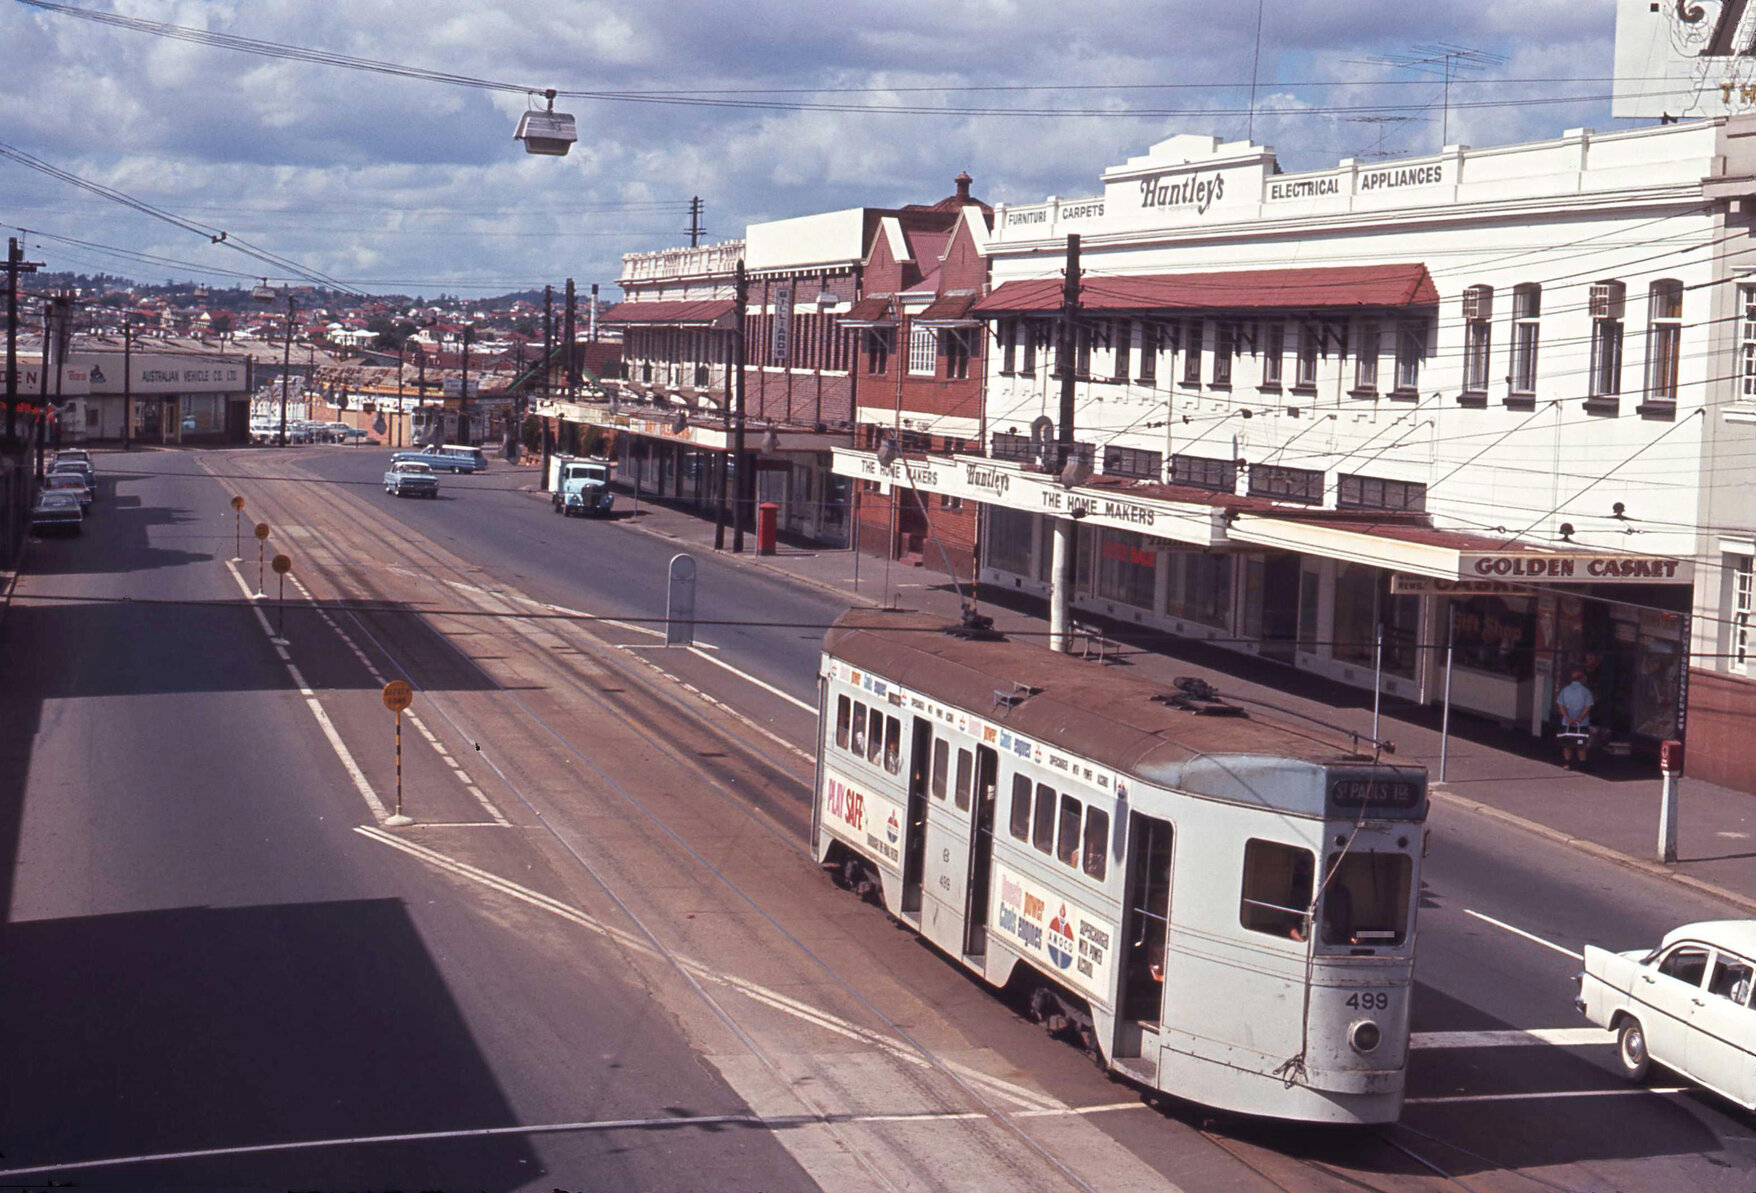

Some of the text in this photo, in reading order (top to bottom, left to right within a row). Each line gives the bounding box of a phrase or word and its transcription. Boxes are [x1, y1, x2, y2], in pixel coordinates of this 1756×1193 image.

[1140, 171, 1224, 215] Huntley's
[1272, 165, 1442, 200] ELECTRICAL APPLIANCES
[1008, 204, 1104, 226] FURNITURE CARPETS
[142, 370, 179, 382] AUSTRALIAN
[184, 370, 209, 382] VEHICLE
[861, 459, 876, 475] THE
[966, 463, 1010, 497] Huntley's
[1042, 491, 1155, 526] THE HOME MAKERS
[1474, 557, 1679, 578] GOLDEN CASKET
[827, 778, 864, 831] PLAY SAFE
[1345, 992, 1388, 1010] 499
